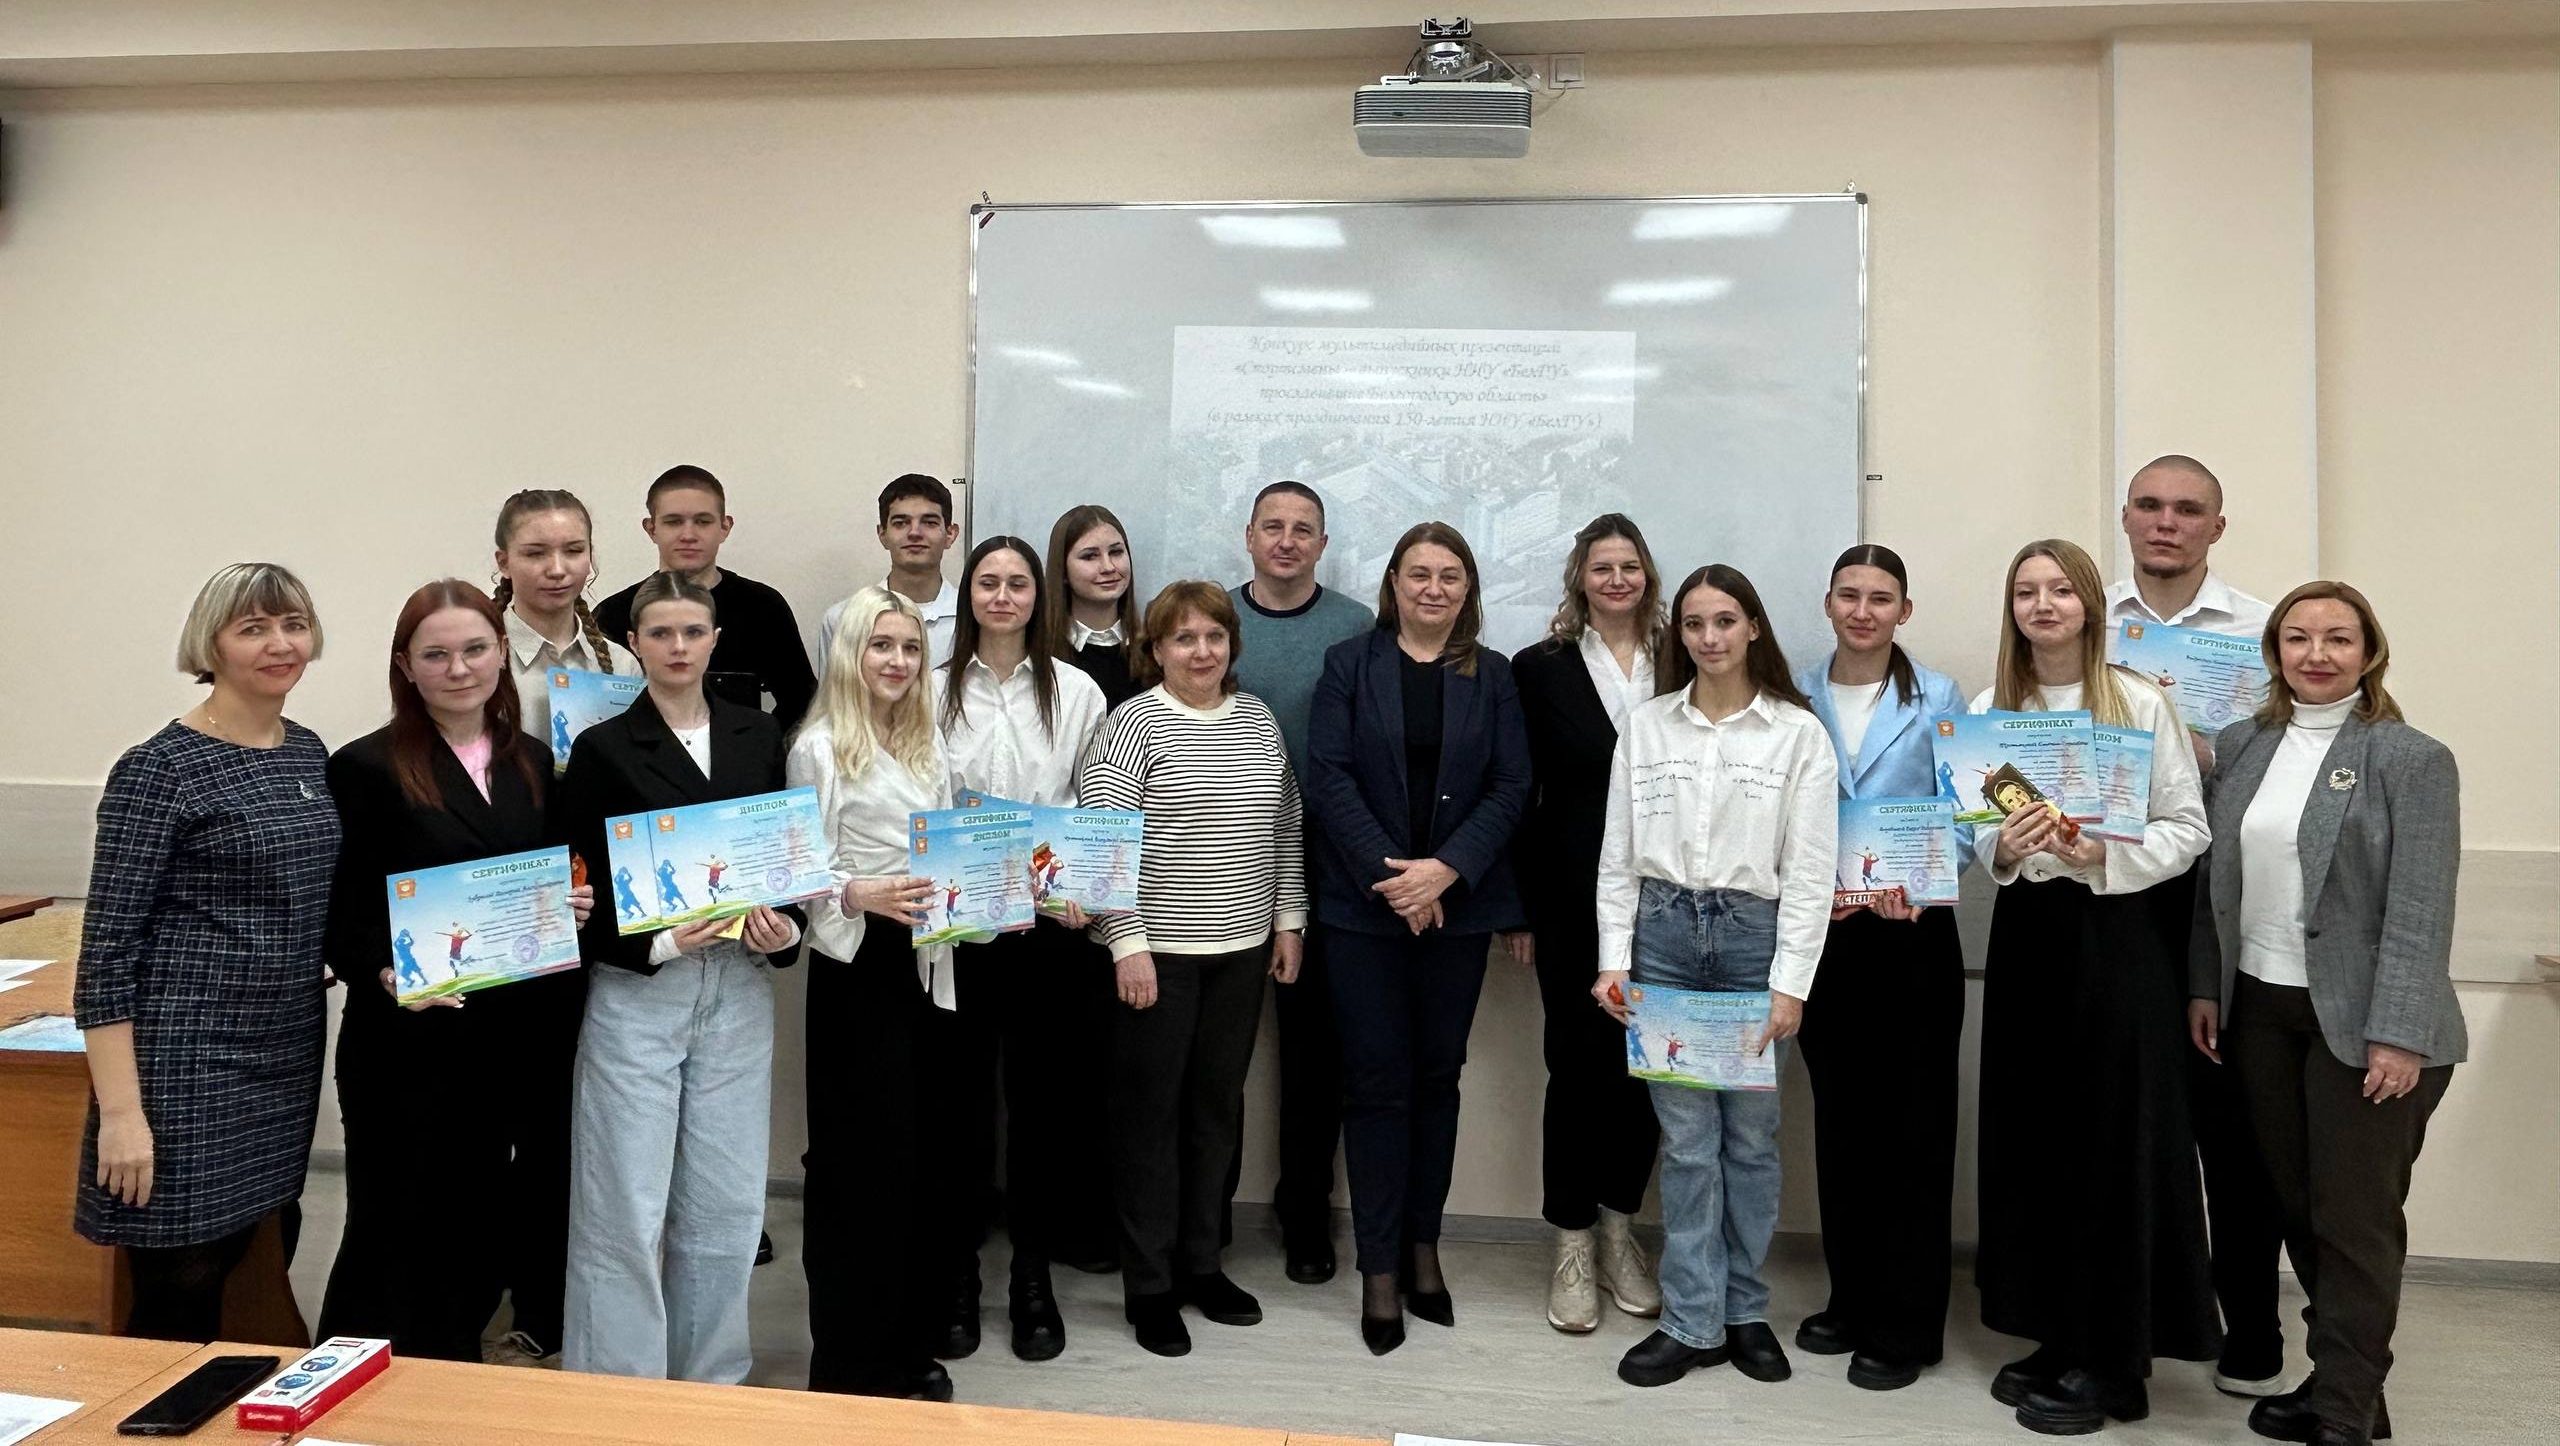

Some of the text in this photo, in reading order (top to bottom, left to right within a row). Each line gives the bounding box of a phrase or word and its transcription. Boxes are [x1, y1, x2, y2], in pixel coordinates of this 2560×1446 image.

[1249, 336, 1314, 355] Конкурс
[2190, 637, 2260, 653] СЕРТИФИКАТ
[2003, 719, 2075, 729] СЕРТИФИКАТ
[739, 799, 788, 815] ДИПЛОМ
[1880, 804, 1938, 814] СЕРТИФИКАТ
[962, 812, 1018, 825] СЕРТИФИКАТ
[1072, 816, 1131, 826] СЕРТИФИКАТ
[972, 829, 1011, 842] ДИПЛОМ
[471, 858, 551, 879] СЕРТИФИКАТ
